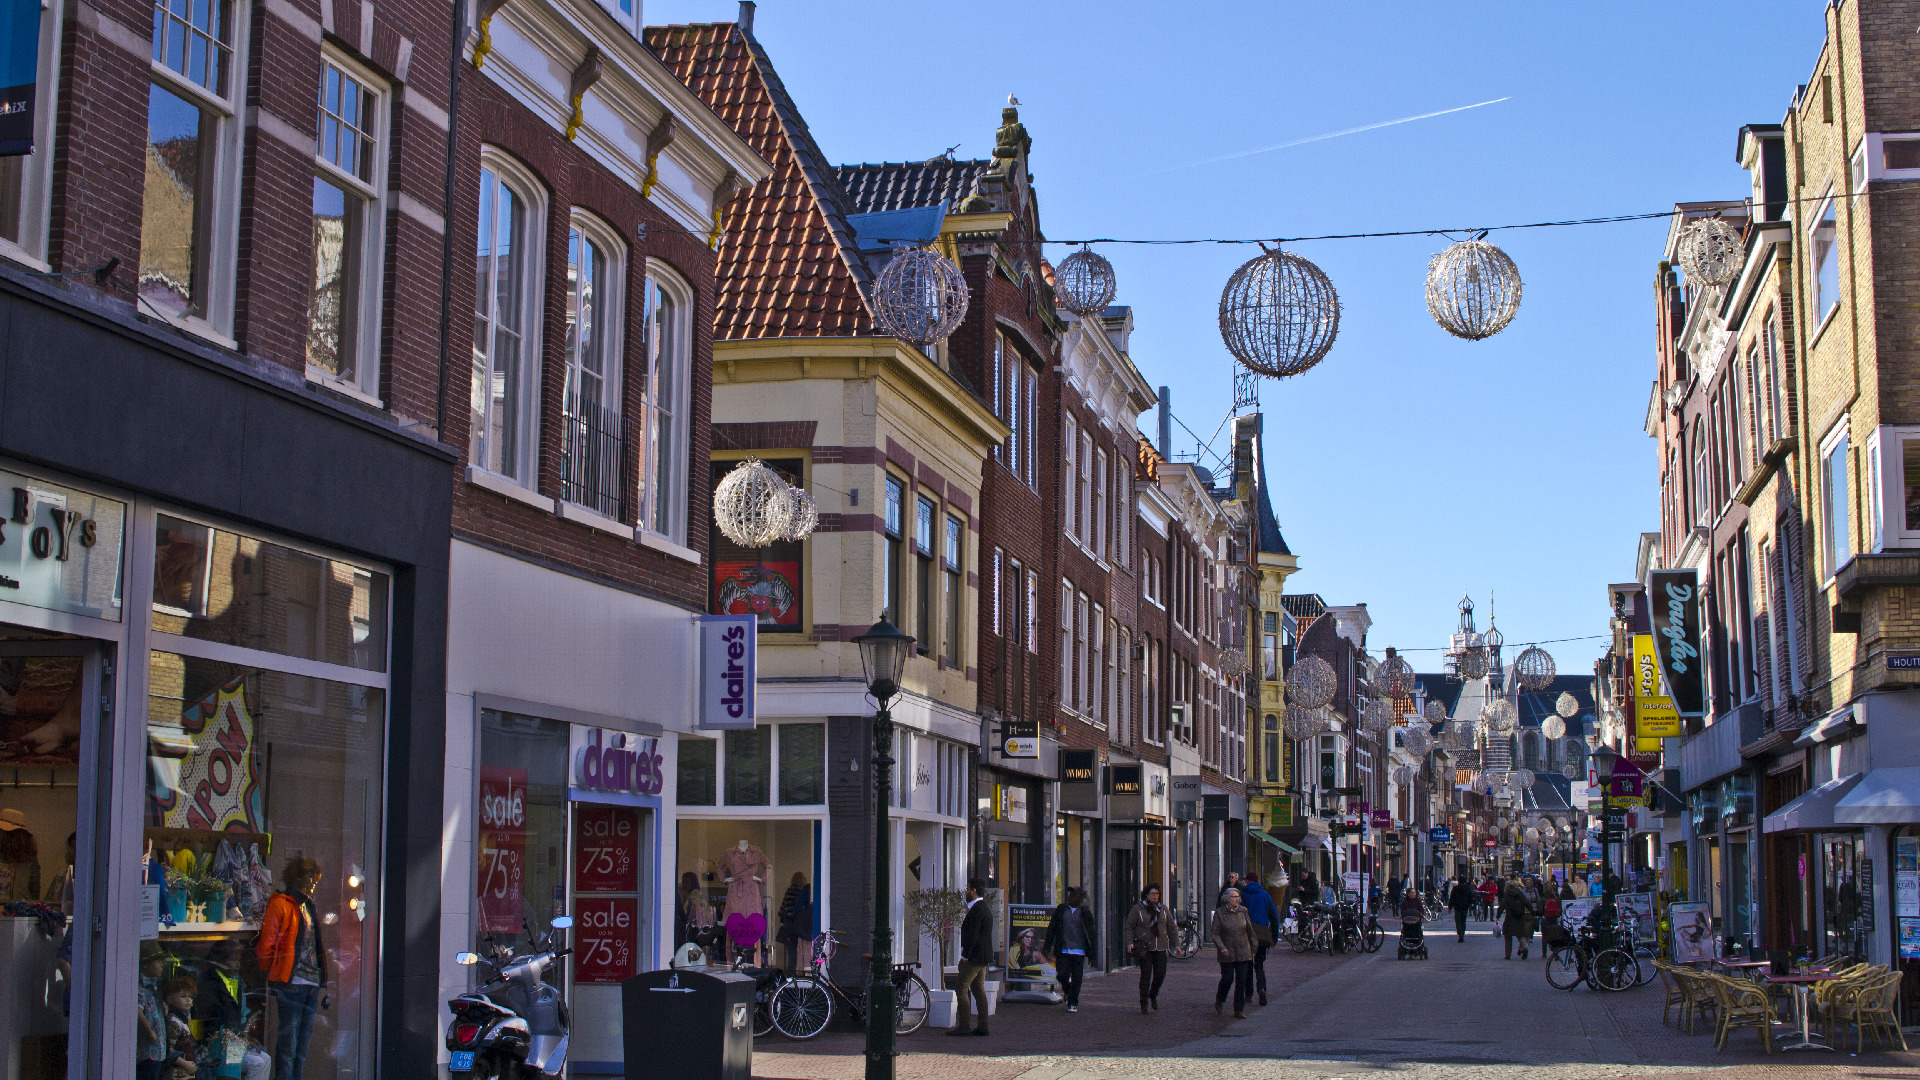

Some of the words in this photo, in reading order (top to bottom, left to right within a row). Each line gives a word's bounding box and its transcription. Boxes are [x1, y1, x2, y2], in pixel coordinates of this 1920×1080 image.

[1662, 582, 1698, 675] Douglas
[721, 625, 745, 719] claire's
[582, 728, 664, 795] claire's
[1173, 781, 1198, 790] Gabor
[482, 777, 524, 828] sale
[583, 810, 631, 837] sale
[582, 900, 630, 928] sale
[582, 938, 613, 965] 75
[616, 955, 628, 966] off
